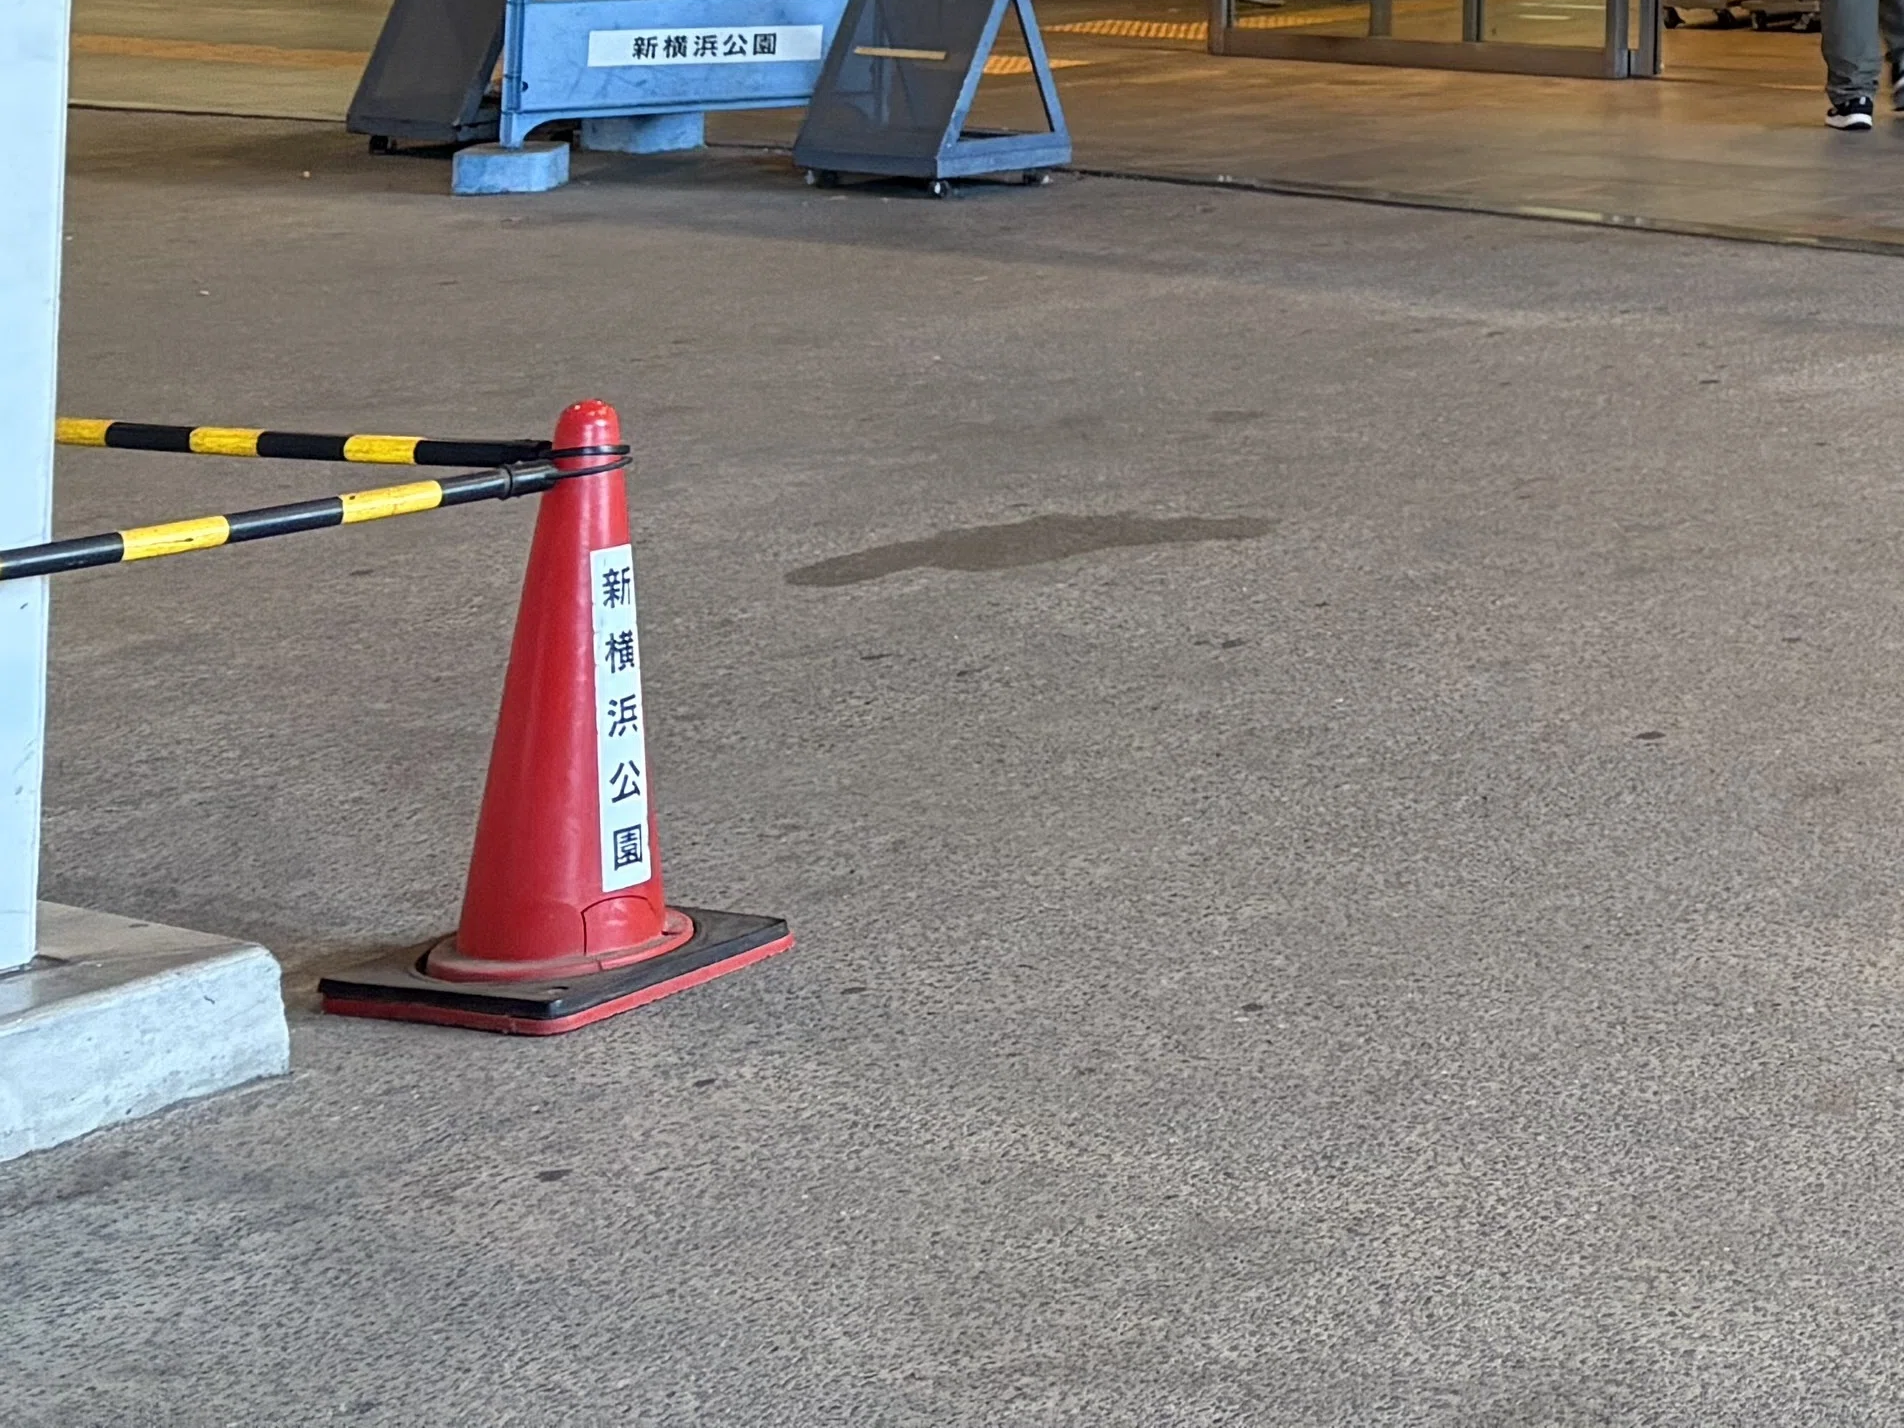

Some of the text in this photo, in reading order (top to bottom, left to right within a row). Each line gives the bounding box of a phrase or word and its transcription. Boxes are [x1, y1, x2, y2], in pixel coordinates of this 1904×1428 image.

[631, 33, 778, 60] 新横浜公園
[601, 565, 645, 872] 新横浜公園
